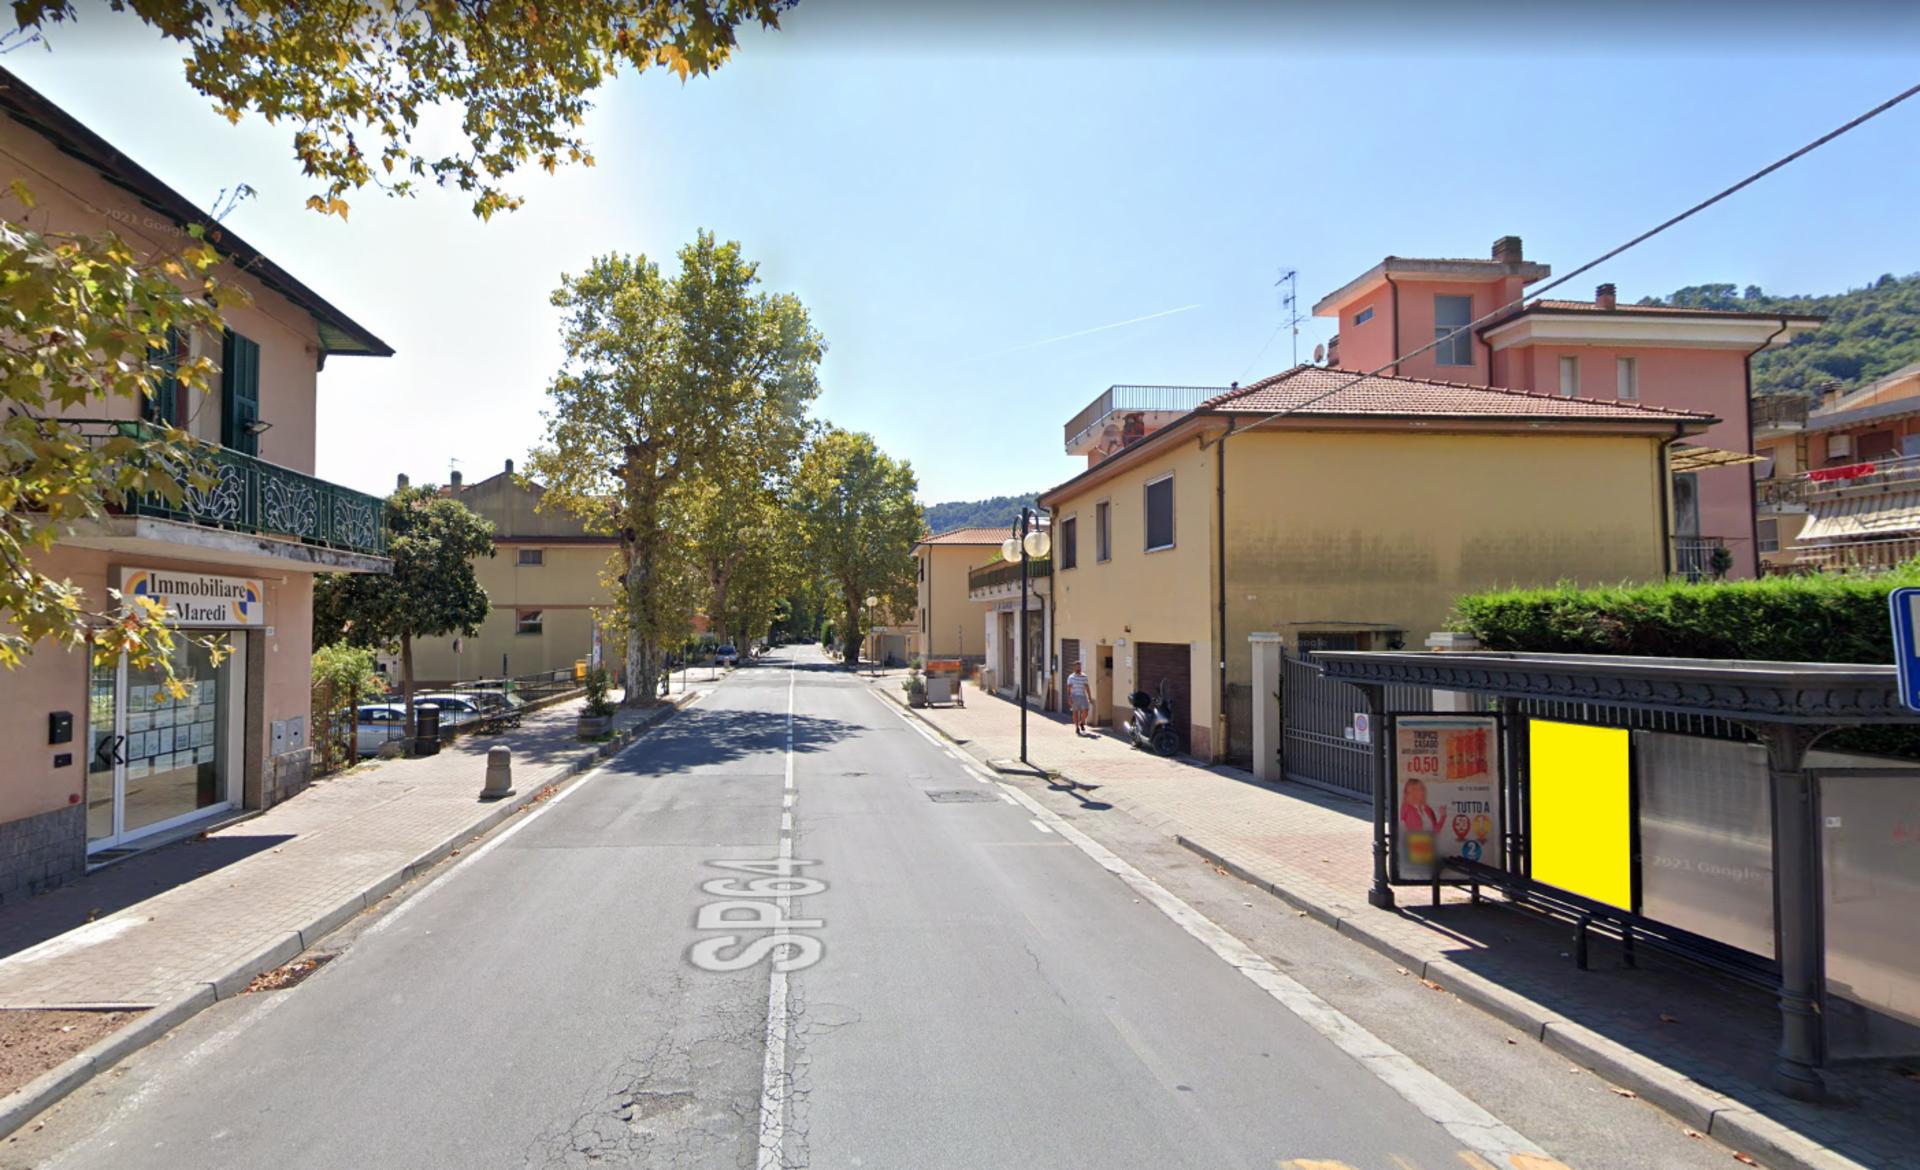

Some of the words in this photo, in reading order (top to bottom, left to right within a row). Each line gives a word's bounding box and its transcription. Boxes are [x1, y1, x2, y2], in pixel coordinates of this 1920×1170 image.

[150, 573, 246, 598] Immobiliare
[175, 602, 226, 621] Maredi
[1484, 801, 1491, 814] A
[1467, 842, 1477, 857] 2
